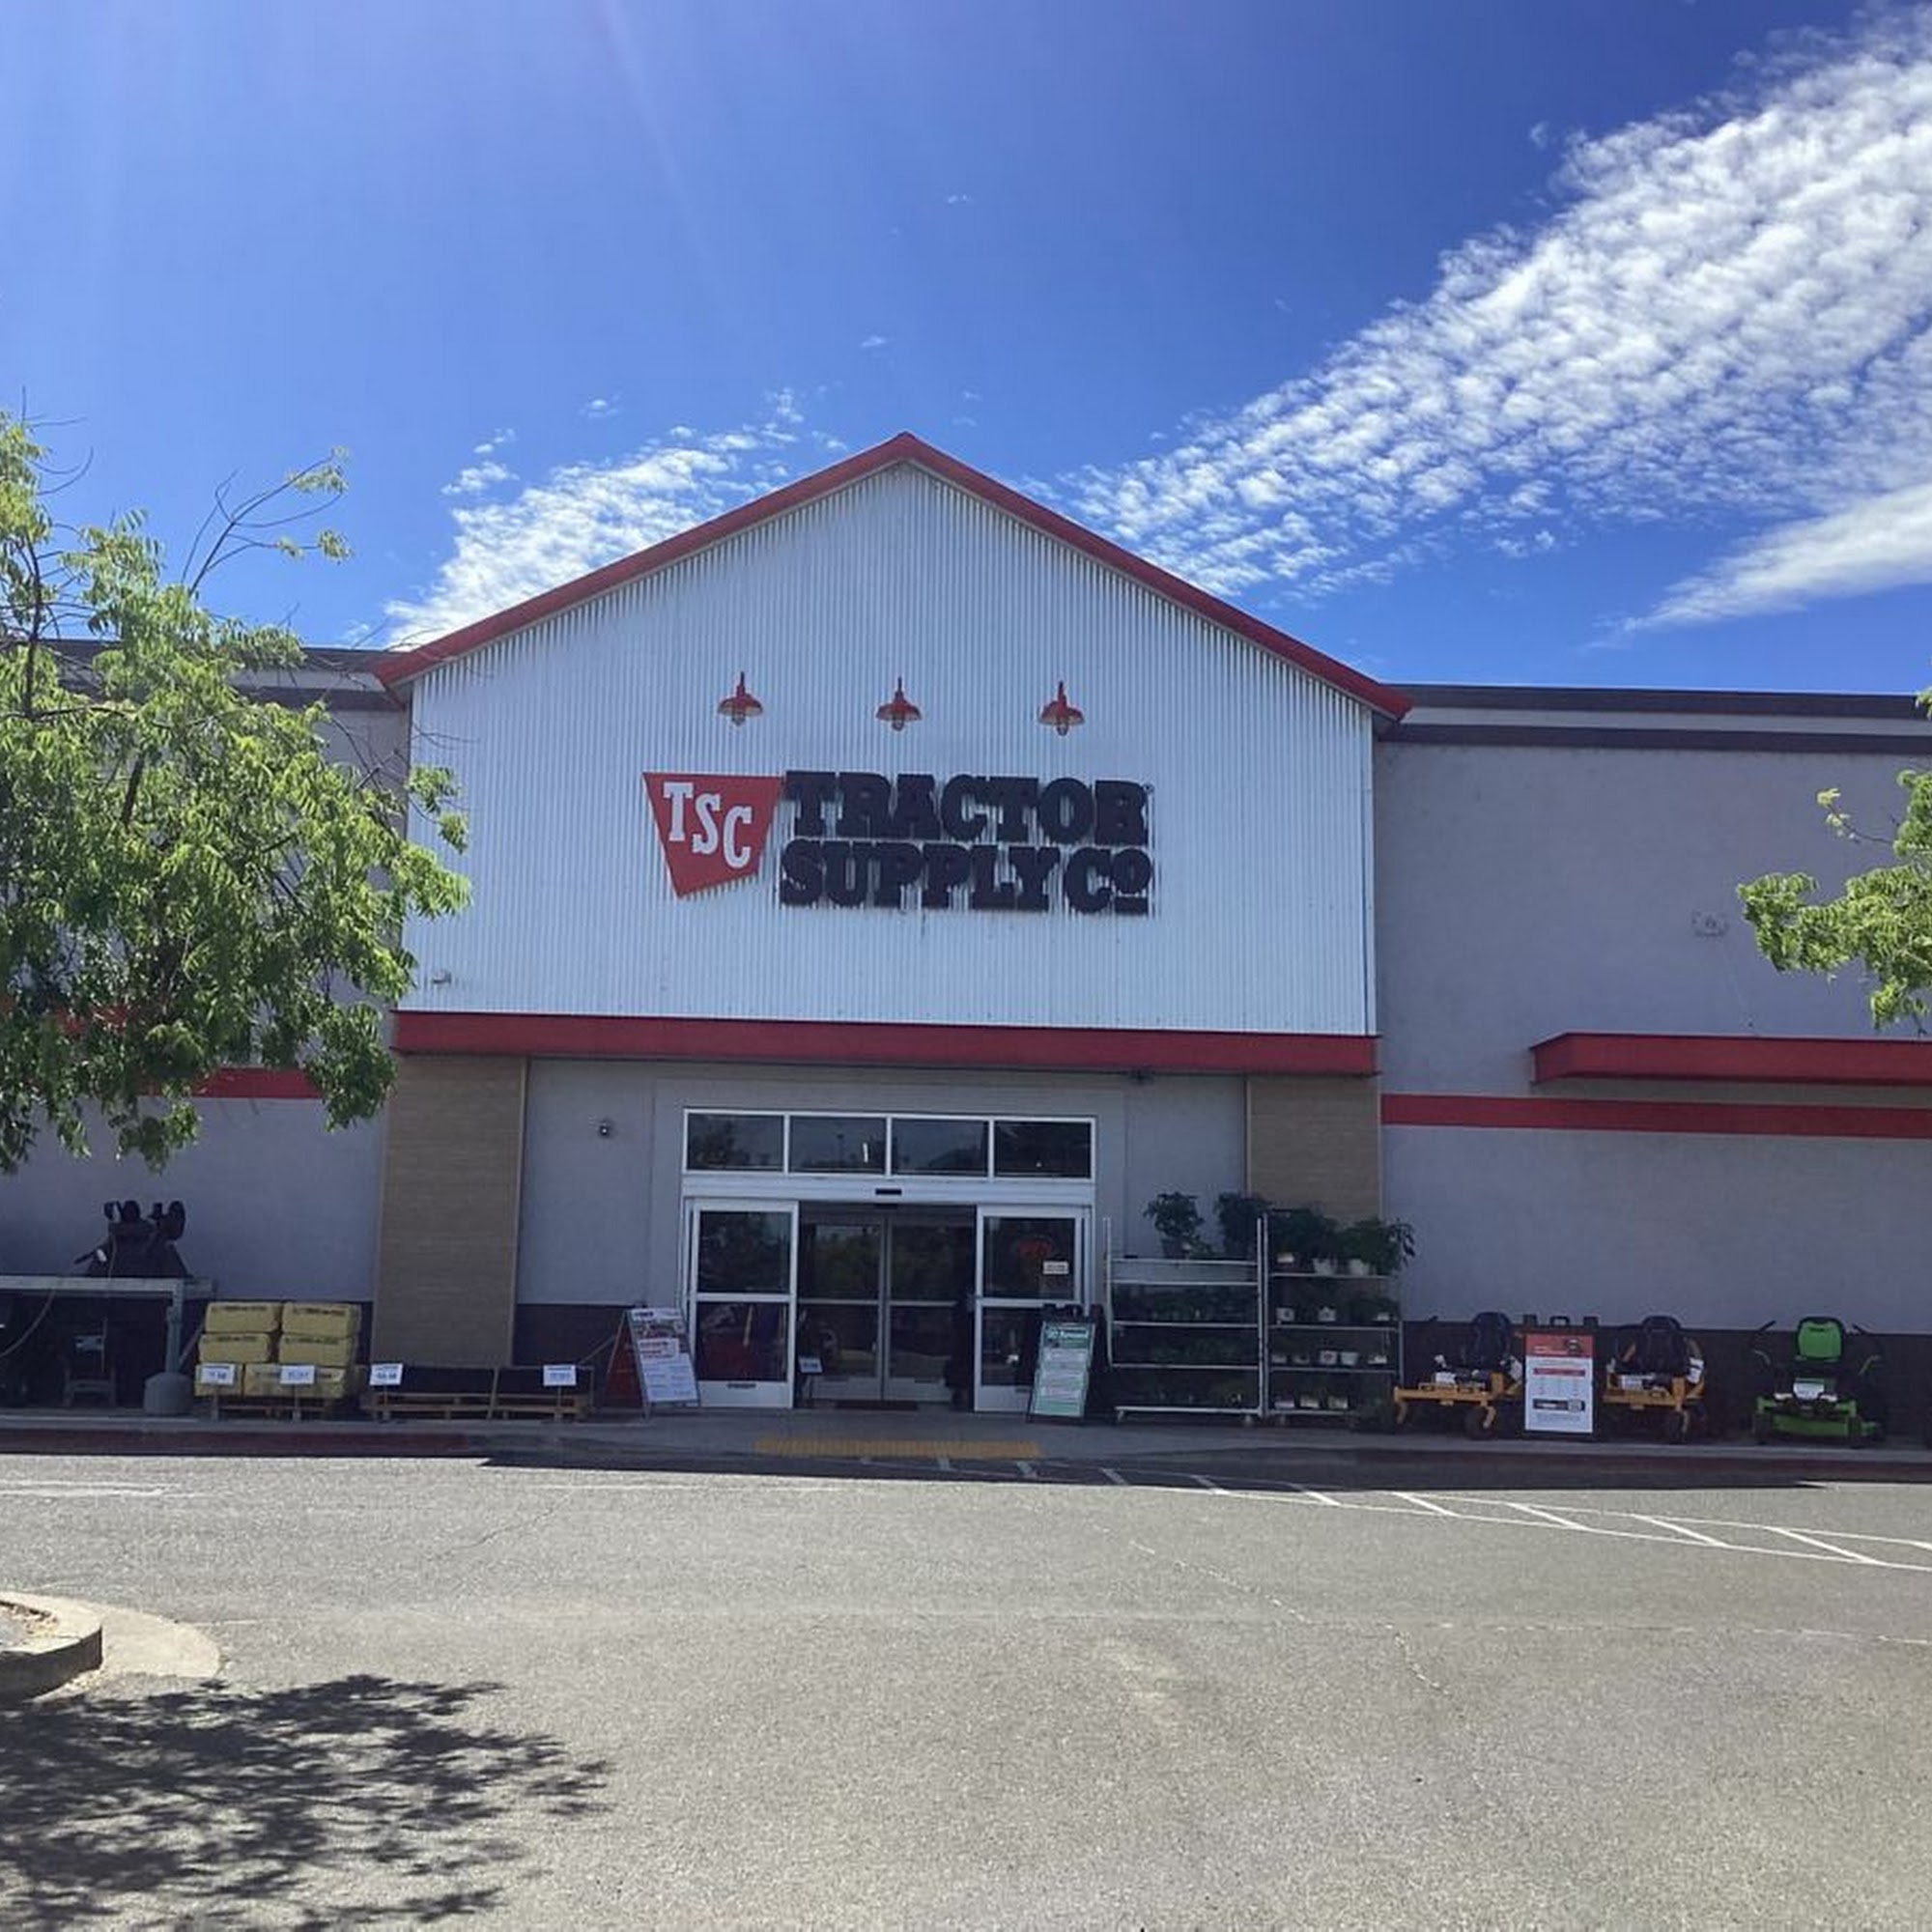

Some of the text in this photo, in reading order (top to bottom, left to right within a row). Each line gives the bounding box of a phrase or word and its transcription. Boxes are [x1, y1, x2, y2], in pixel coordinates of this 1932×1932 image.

[663, 781, 752, 868] TSC
[785, 770, 1147, 845] TRACTOR
[781, 838, 1061, 911] SUPPLY
